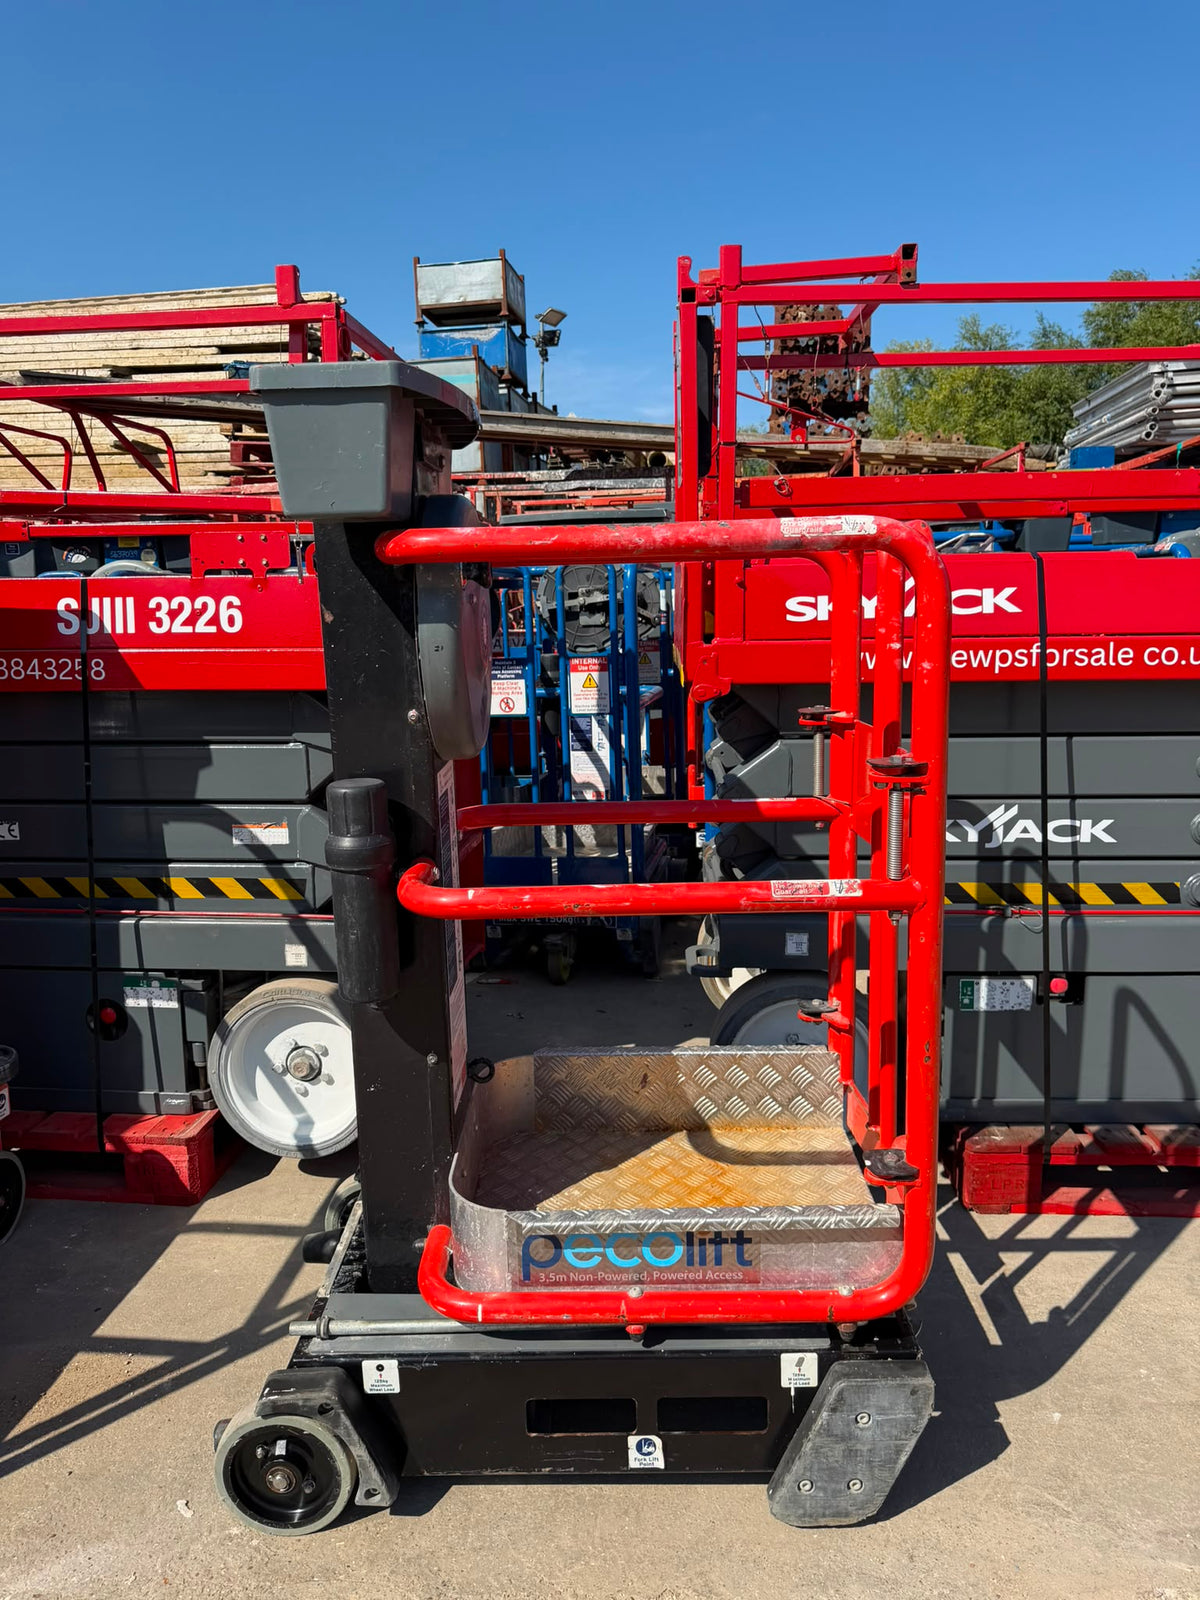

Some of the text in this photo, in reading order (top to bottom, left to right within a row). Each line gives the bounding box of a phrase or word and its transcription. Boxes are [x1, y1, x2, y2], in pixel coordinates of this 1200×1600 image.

[147, 595, 243, 634] 3226
[571, 657, 608, 665] INTERNAL
[588, 664, 601, 672] Only
[946, 804, 1118, 849] YJACK
[521, 1230, 753, 1282] pecolift
[539, 1270, 744, 1282] 3.5m Non-Powered, Powered Access
